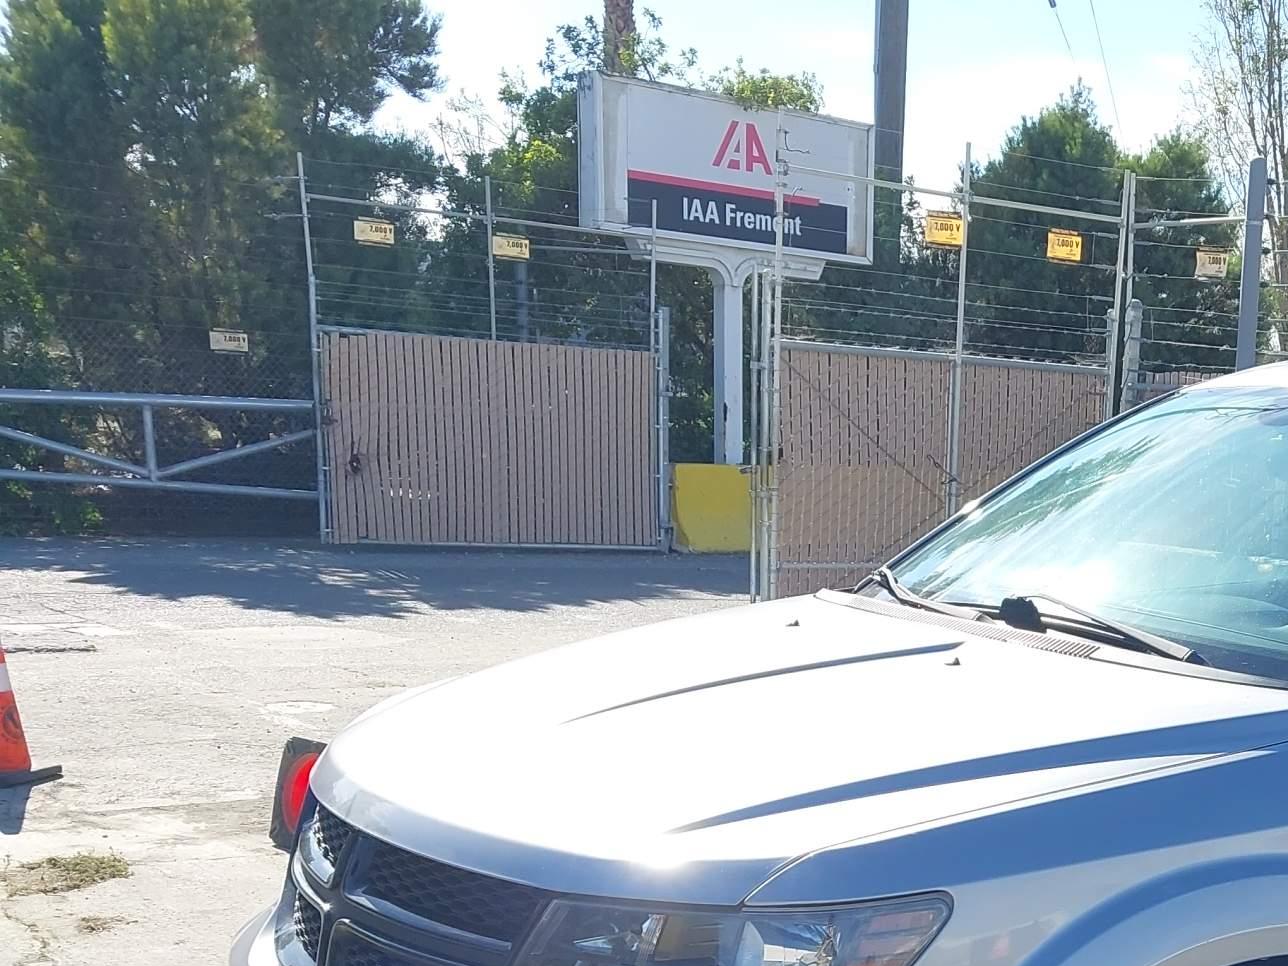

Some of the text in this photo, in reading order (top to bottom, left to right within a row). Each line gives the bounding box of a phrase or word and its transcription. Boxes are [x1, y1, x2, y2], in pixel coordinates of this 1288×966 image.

[682, 196, 720, 224] IAA
[934, 221, 961, 232] 7,000 V
[1075, 240, 1080, 248] V
